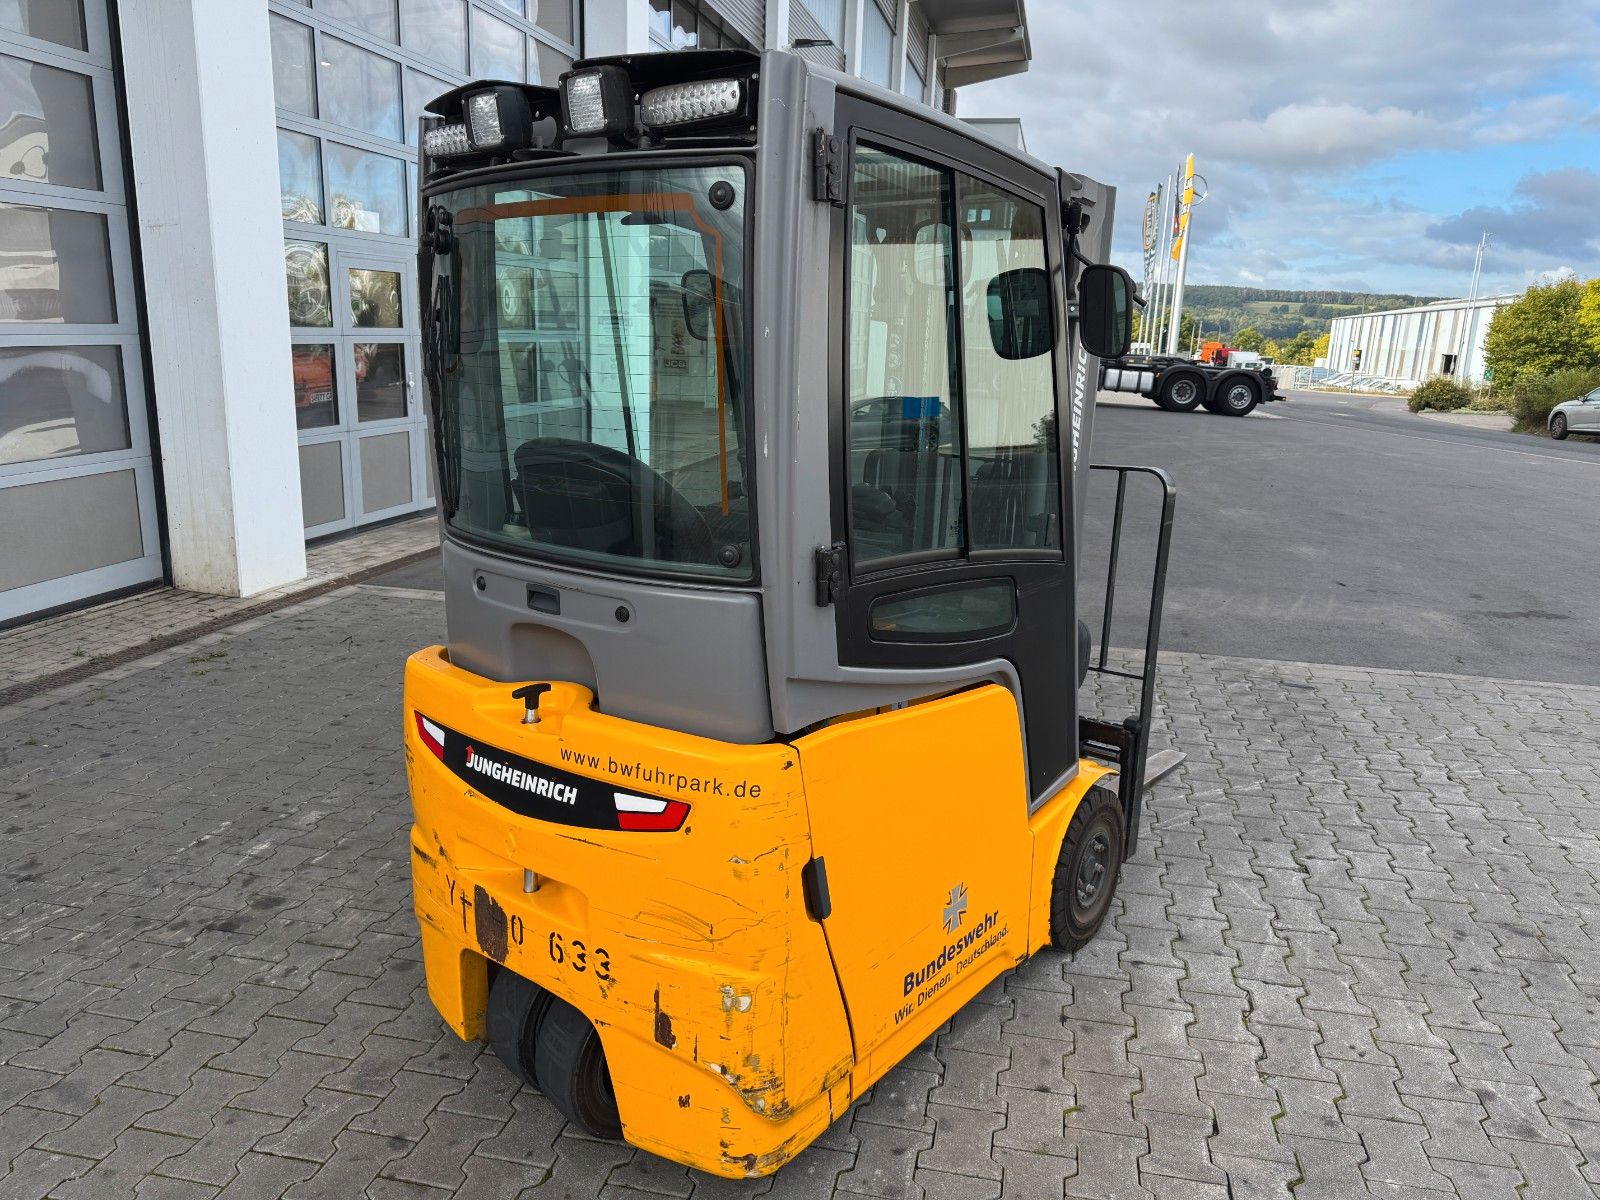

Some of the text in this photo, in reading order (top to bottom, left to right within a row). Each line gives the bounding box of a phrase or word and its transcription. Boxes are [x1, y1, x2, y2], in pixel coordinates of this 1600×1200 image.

[466, 745, 578, 806] JUNGHEINRICH
[560, 747, 762, 799] www.bwfuhrpark.de
[549, 931, 611, 981] 633
[894, 922, 1008, 1025] Wir. Dienen. Deutschland.
[903, 909, 998, 997] Bundeswehr
